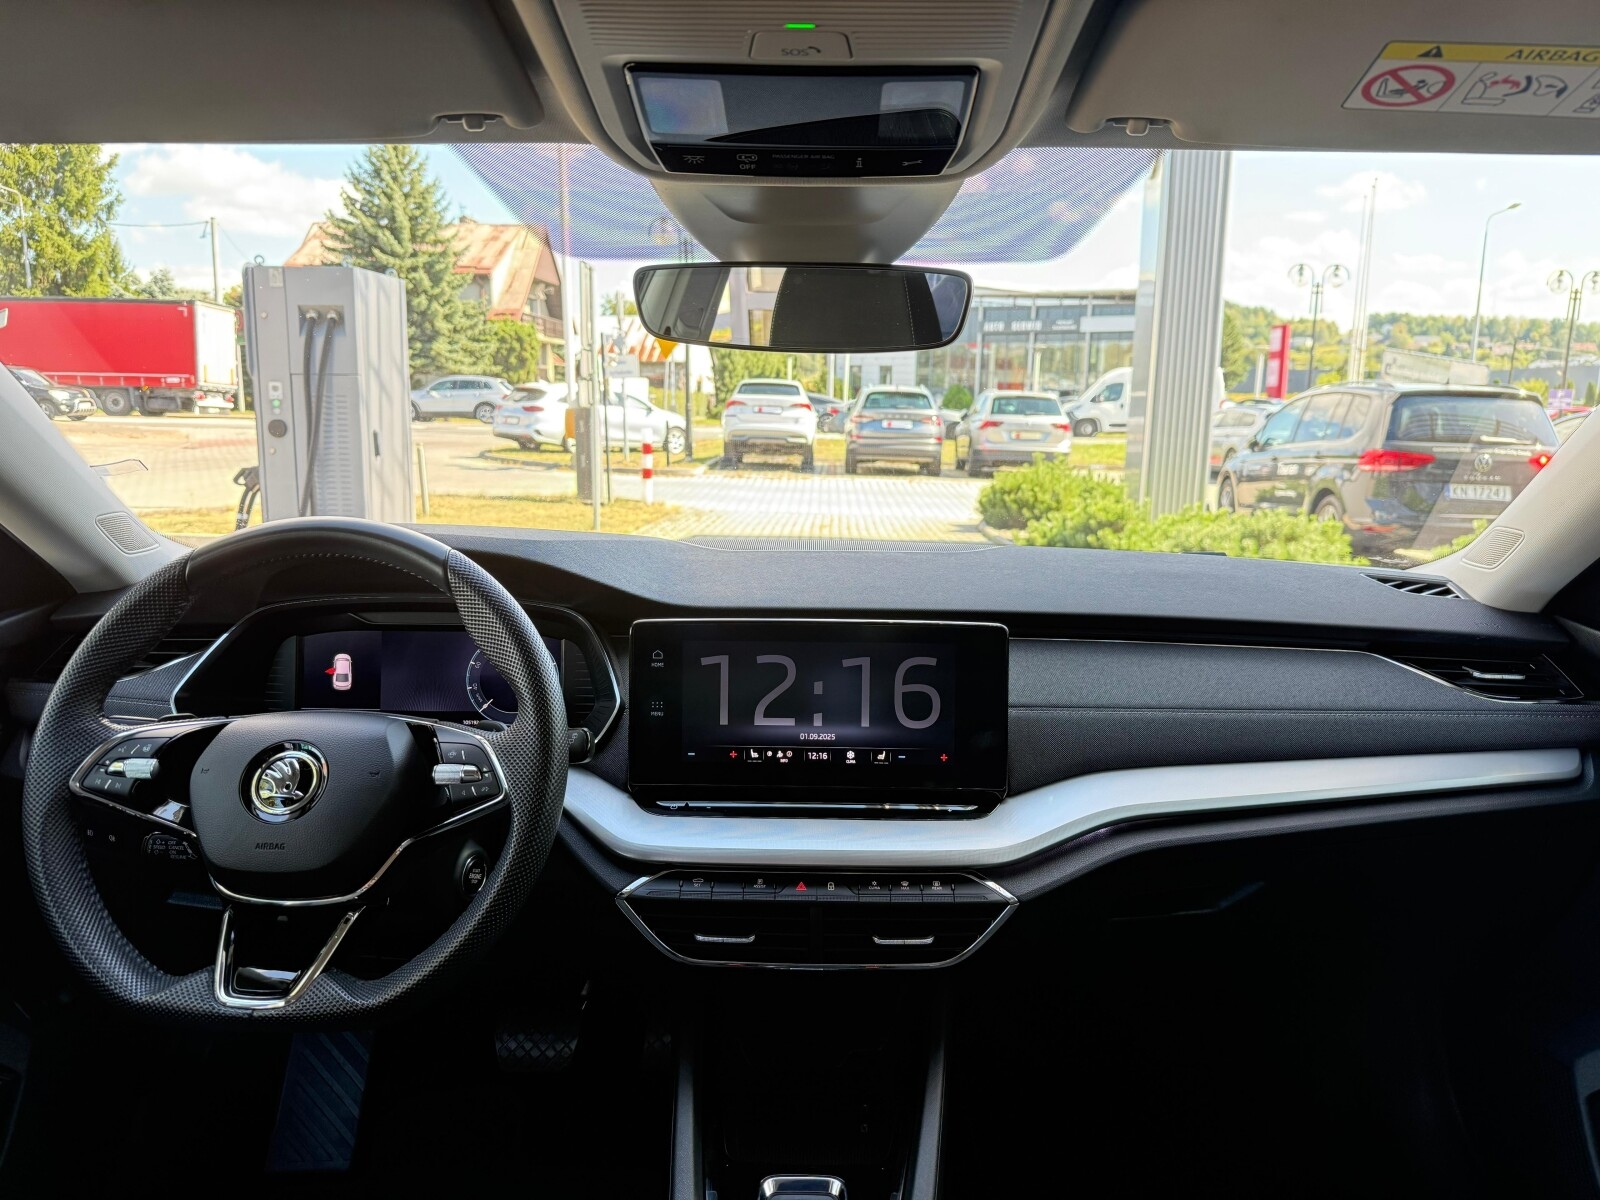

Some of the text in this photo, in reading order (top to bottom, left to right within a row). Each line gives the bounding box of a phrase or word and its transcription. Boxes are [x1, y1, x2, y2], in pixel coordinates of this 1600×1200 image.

[781, 48, 809, 57] SOS
[1504, 49, 1600, 63] AIRBAG
[700, 654, 942, 730] 12:16
[799, 733, 836, 741] 01.09.2025
[807, 752, 828, 760] 12:16
[254, 842, 286, 850] AIRBAG
[468, 872, 483, 880] ENGINE
